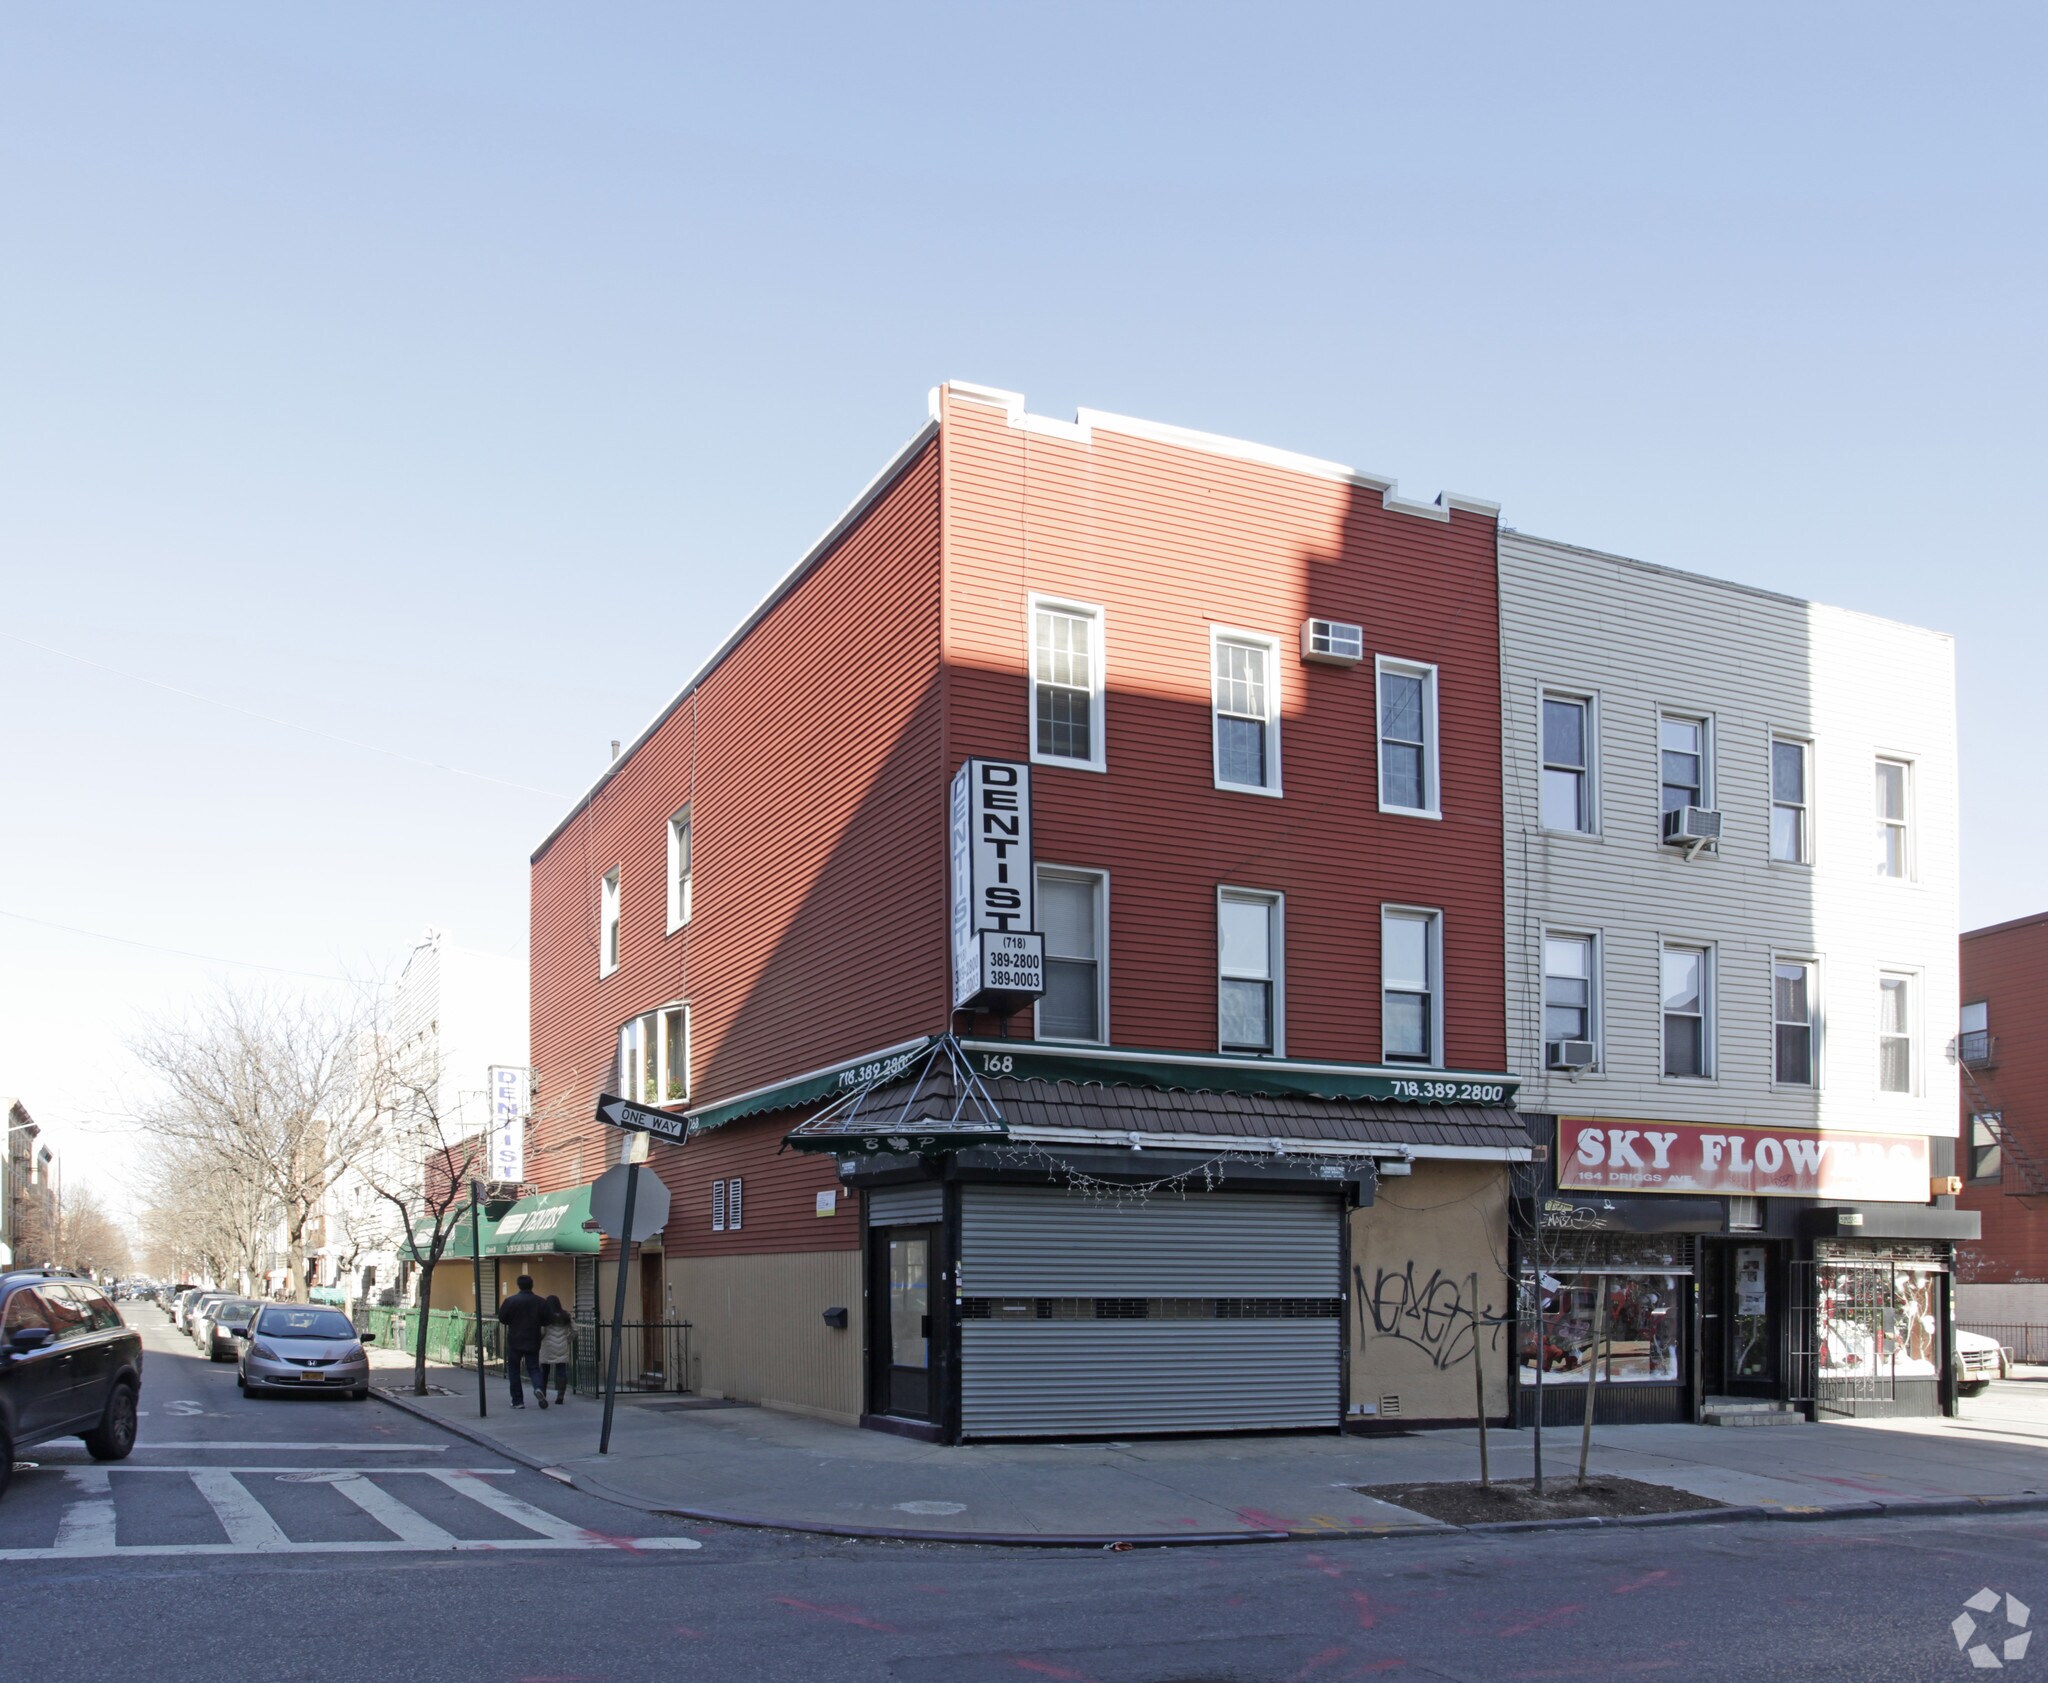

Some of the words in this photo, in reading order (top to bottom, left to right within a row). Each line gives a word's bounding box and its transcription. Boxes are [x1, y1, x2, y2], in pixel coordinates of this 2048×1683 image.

[982, 765, 1021, 931] DENTIST
[954, 773, 966, 946] DENTIST
[1003, 937, 1026, 949] (718)
[990, 952, 1040, 969] 389-2800
[990, 971, 1040, 987] 389-0003
[839, 1053, 914, 1087] 718.389280
[983, 1054, 1013, 1073] 168
[1391, 1081, 1503, 1101] 718.389.2800
[498, 1071, 518, 1177] DENTIST
[622, 1109, 647, 1125] ONE
[653, 1117, 678, 1133] WAY
[863, 1138, 879, 1150] B
[1577, 1128, 1678, 1169] SKY
[1578, 1172, 1602, 1180] 164
[1609, 1172, 1662, 1182] DRIGGS
